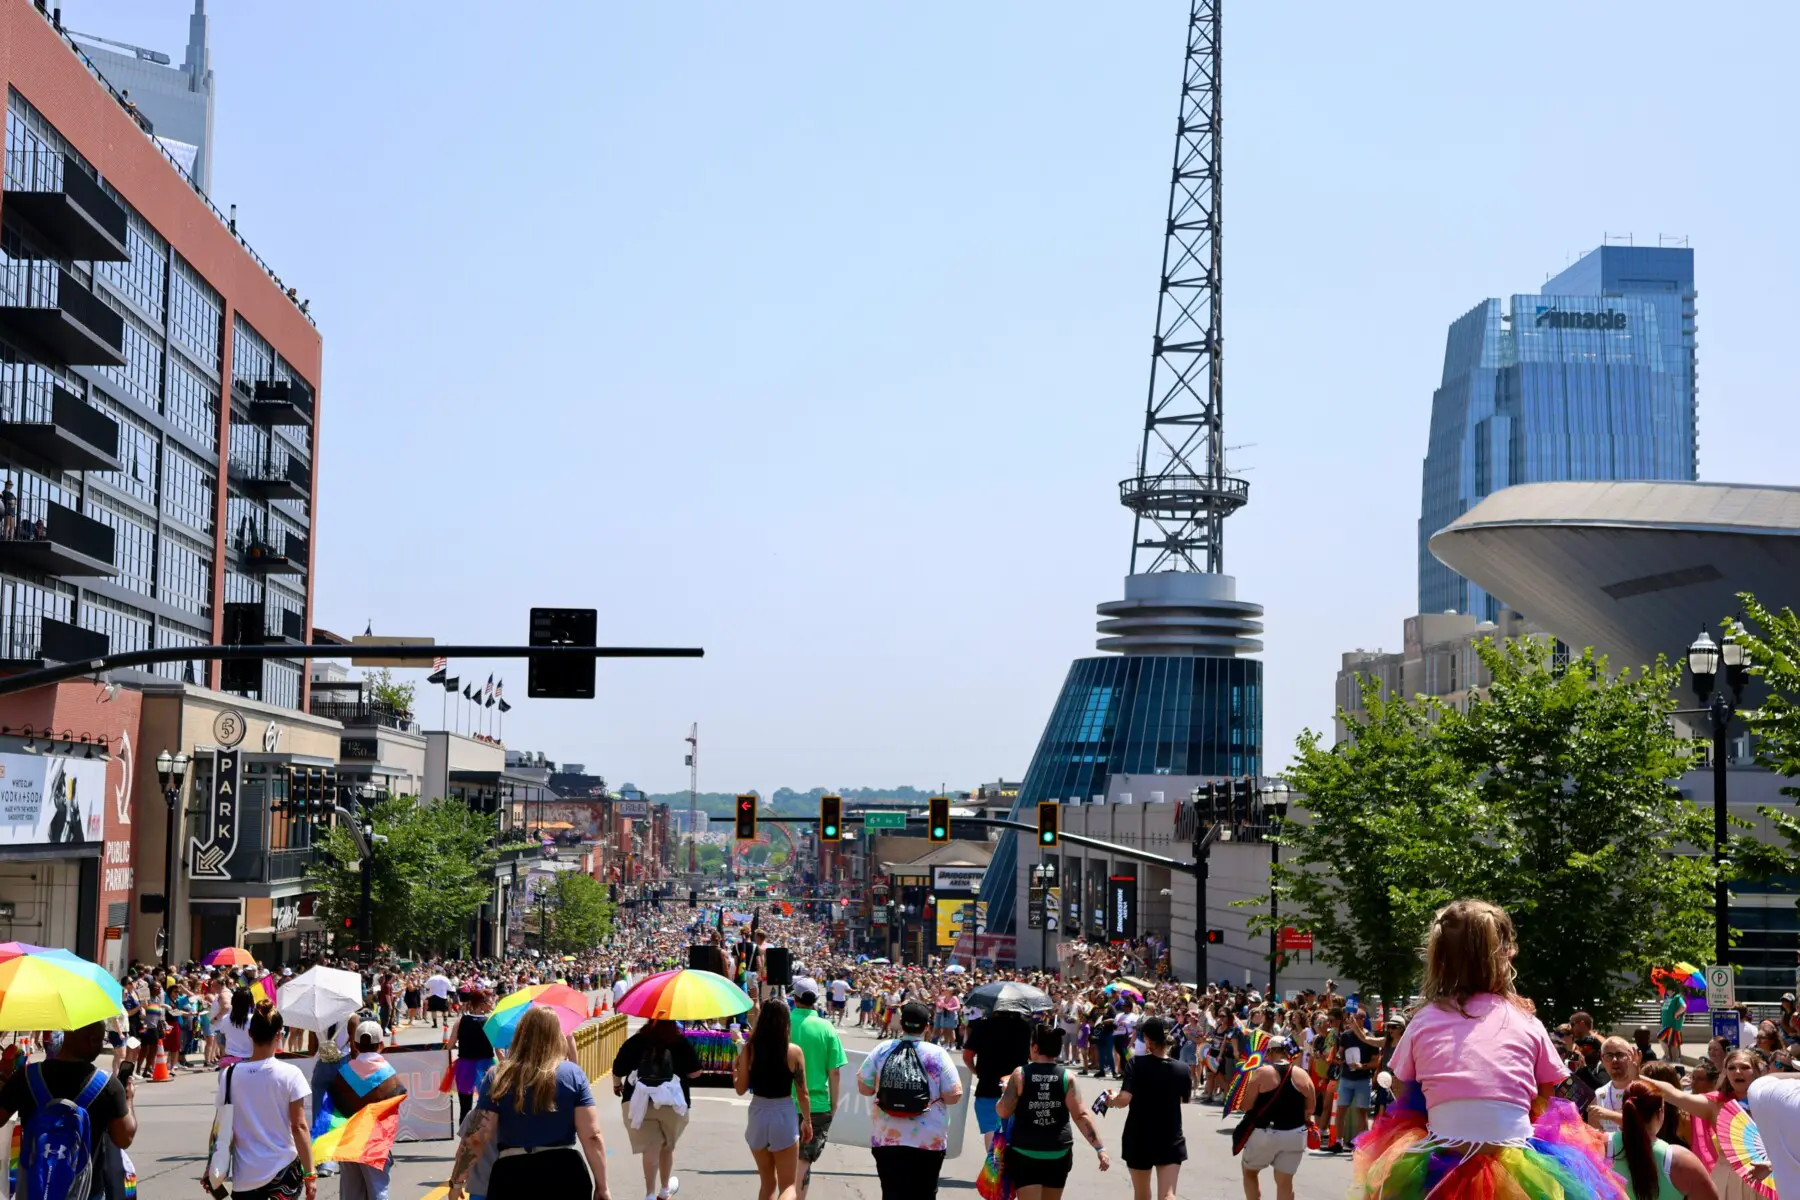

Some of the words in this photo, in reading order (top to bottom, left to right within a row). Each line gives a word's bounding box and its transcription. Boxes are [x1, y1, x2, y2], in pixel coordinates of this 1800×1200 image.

[1536, 306, 1627, 330] Pinnacle
[219, 759, 232, 838] PARK
[106, 840, 131, 864] PUBLIC
[105, 867, 134, 891] PARKING
[1717, 973, 1723, 983] P
